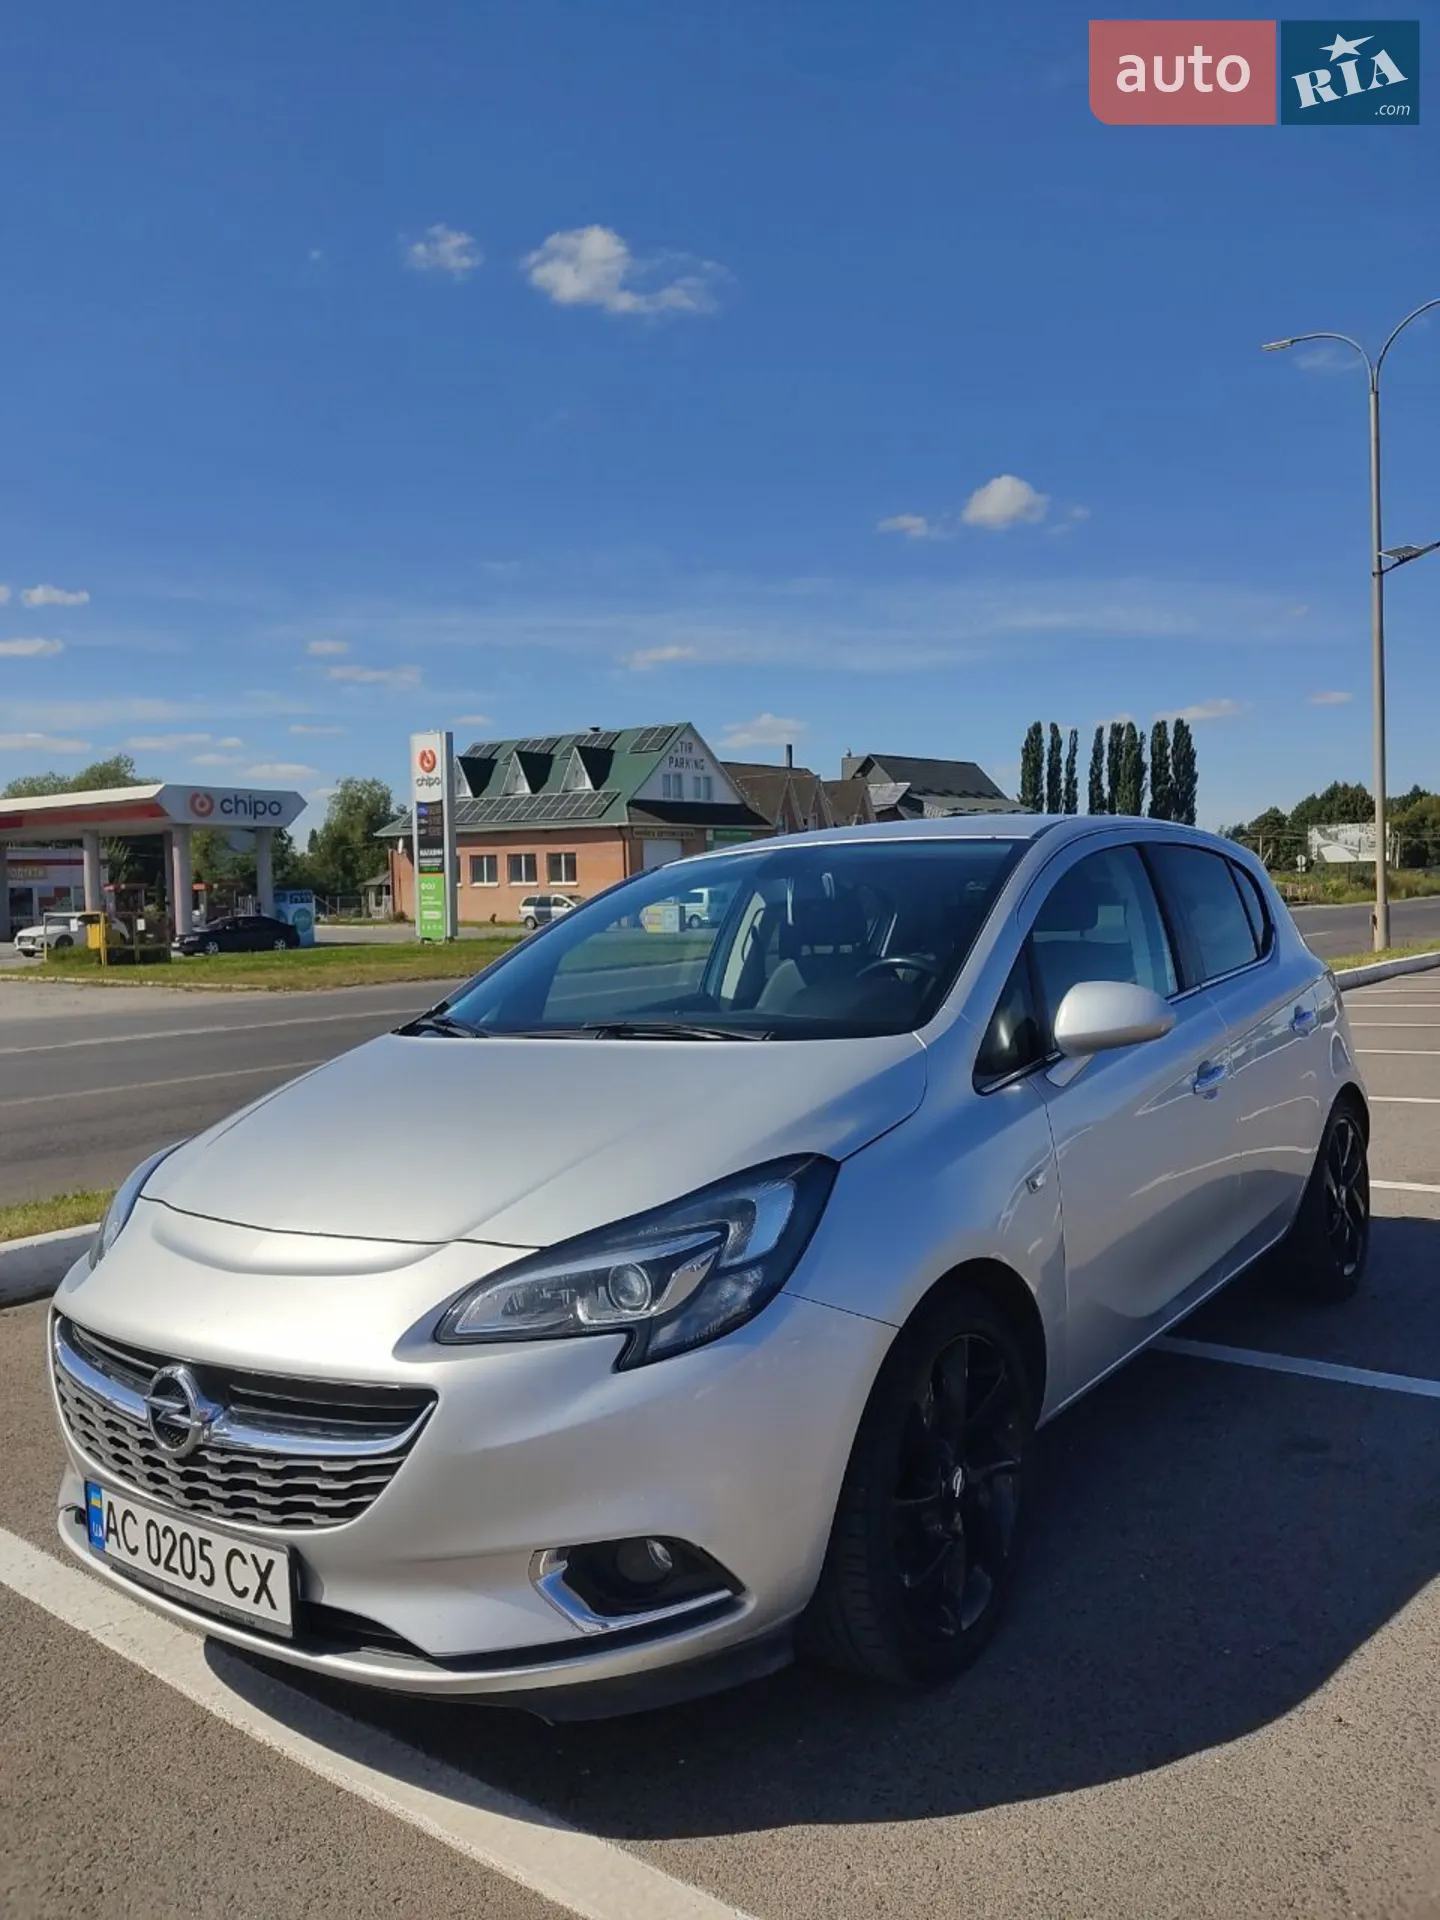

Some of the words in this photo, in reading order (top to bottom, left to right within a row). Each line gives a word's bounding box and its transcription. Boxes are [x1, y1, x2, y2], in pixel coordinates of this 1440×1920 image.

[679, 741, 694, 754] TIR
[668, 756, 705, 771] PARKING
[416, 776, 441, 788] chipo
[220, 794, 282, 820] chipo
[105, 1500, 139, 1556] AC
[145, 1519, 215, 1587] 0205
[224, 1547, 278, 1611] CX
